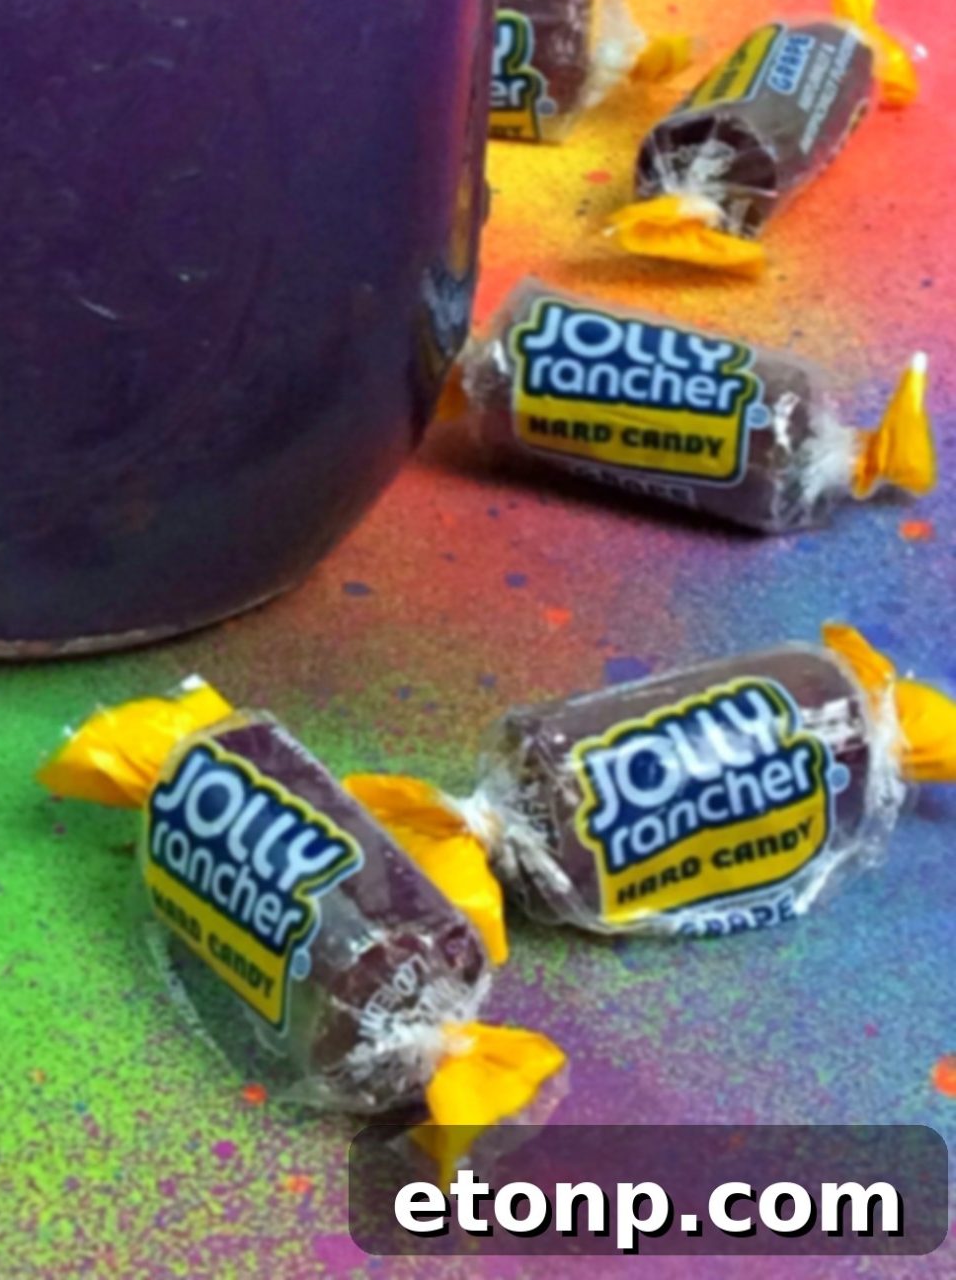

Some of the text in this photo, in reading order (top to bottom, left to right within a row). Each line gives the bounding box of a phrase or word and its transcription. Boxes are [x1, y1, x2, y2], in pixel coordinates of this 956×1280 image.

[524, 305, 734, 372] JOLLY
[529, 355, 741, 410] rancher
[528, 415, 726, 459] HARD CANDY
[587, 689, 779, 830] JOLLY
[154, 750, 343, 892] JOLLY
[610, 748, 811, 867] rancher
[151, 820, 303, 946] rancher
[616, 815, 817, 905] HARD CANDY
[152, 886, 203, 943] HARD
